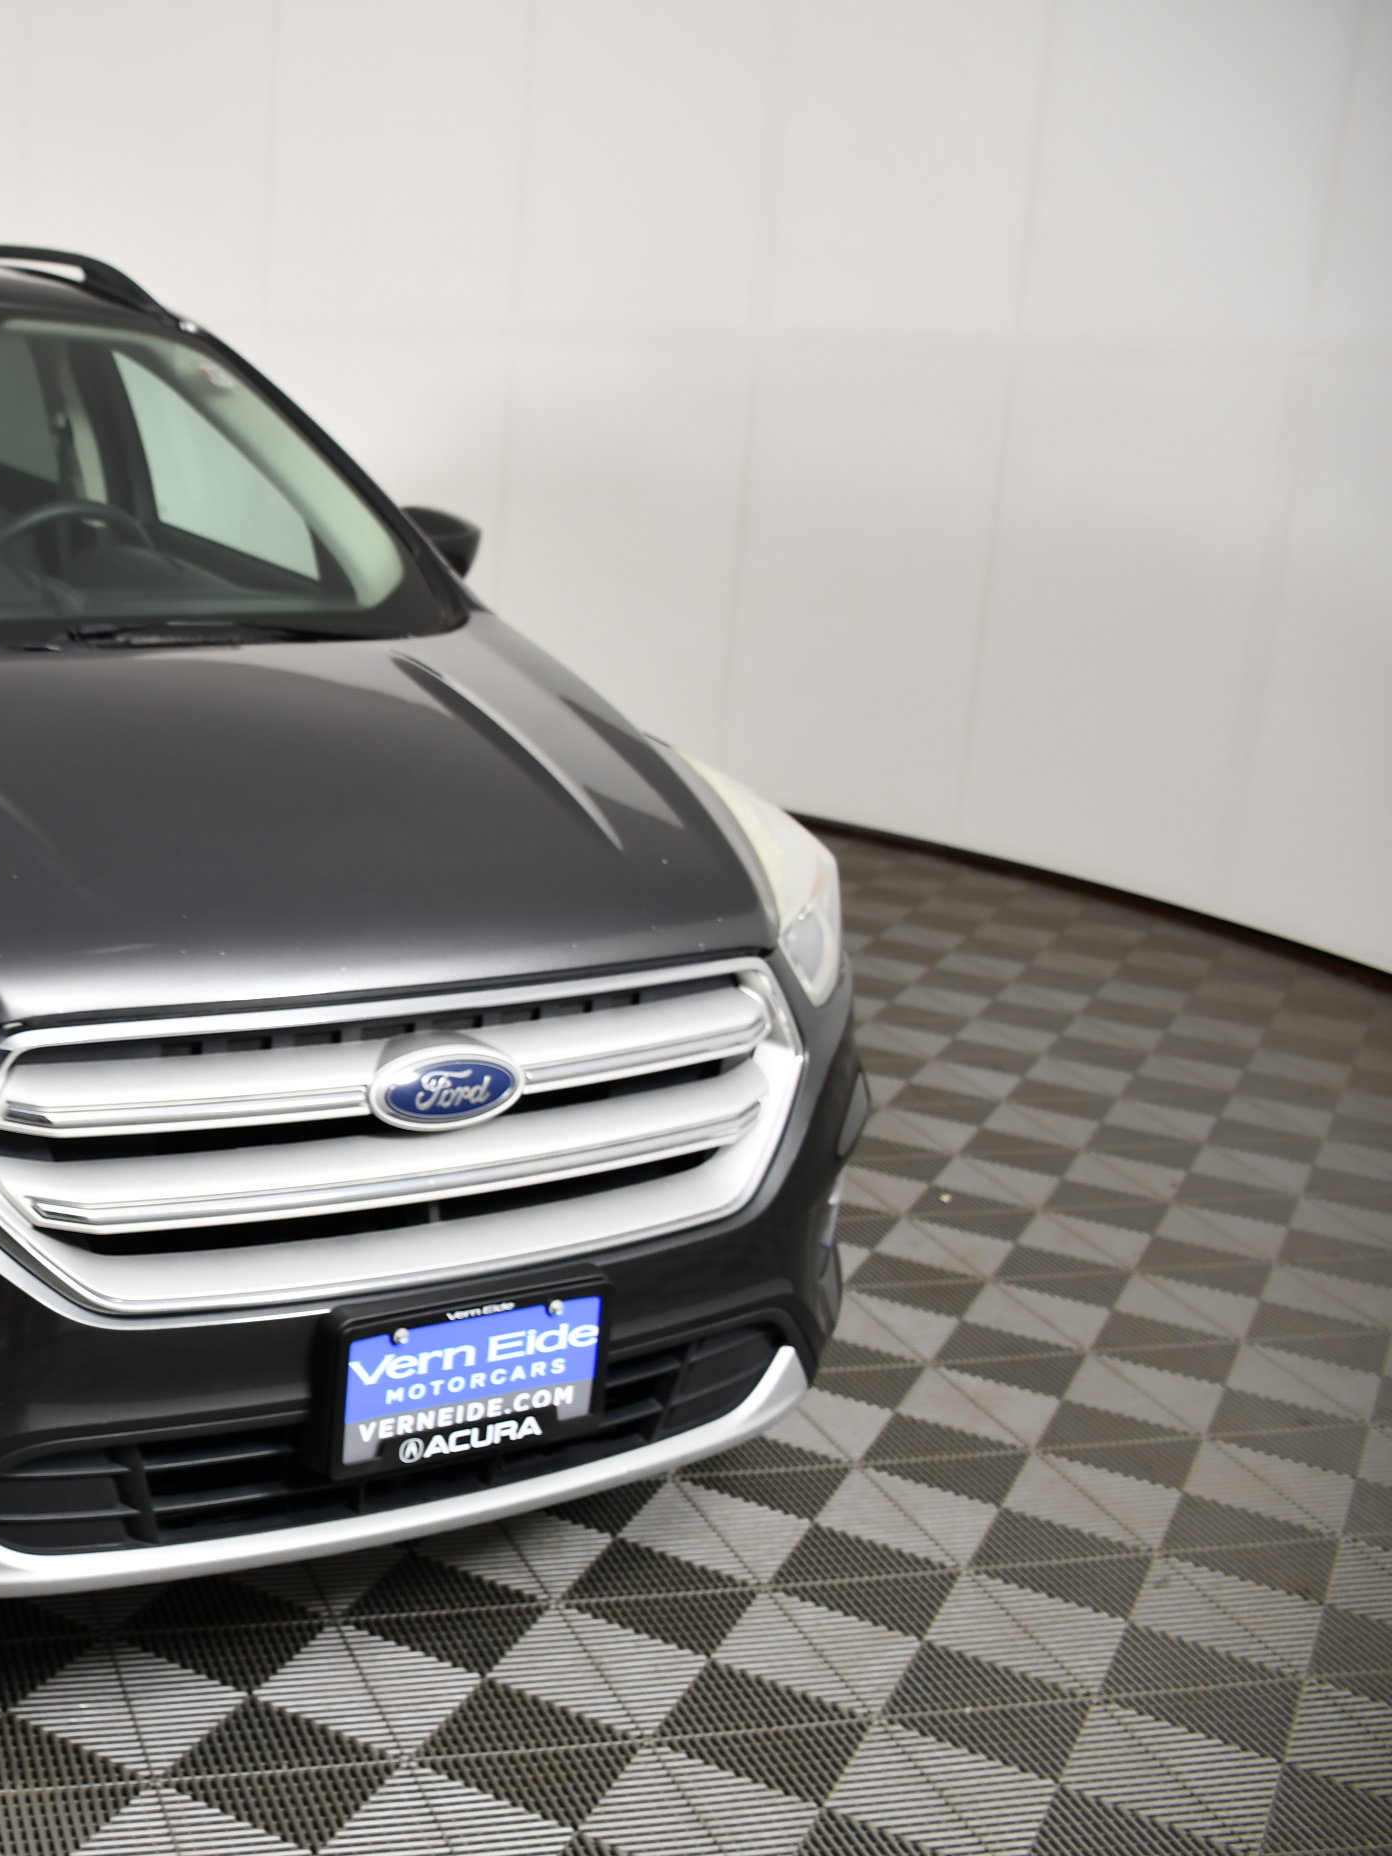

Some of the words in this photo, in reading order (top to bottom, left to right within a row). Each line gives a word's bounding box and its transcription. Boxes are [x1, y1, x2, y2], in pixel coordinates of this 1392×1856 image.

[415, 1069, 491, 1111] Ford
[446, 1307, 481, 1320] Vern
[482, 1302, 516, 1314] Eide
[348, 1344, 476, 1386] Vern
[487, 1323, 599, 1362] Eide
[385, 1357, 566, 1404] MOTORCARS
[358, 1385, 574, 1442] VERNEIDE.COM
[423, 1416, 542, 1458] ACURA
